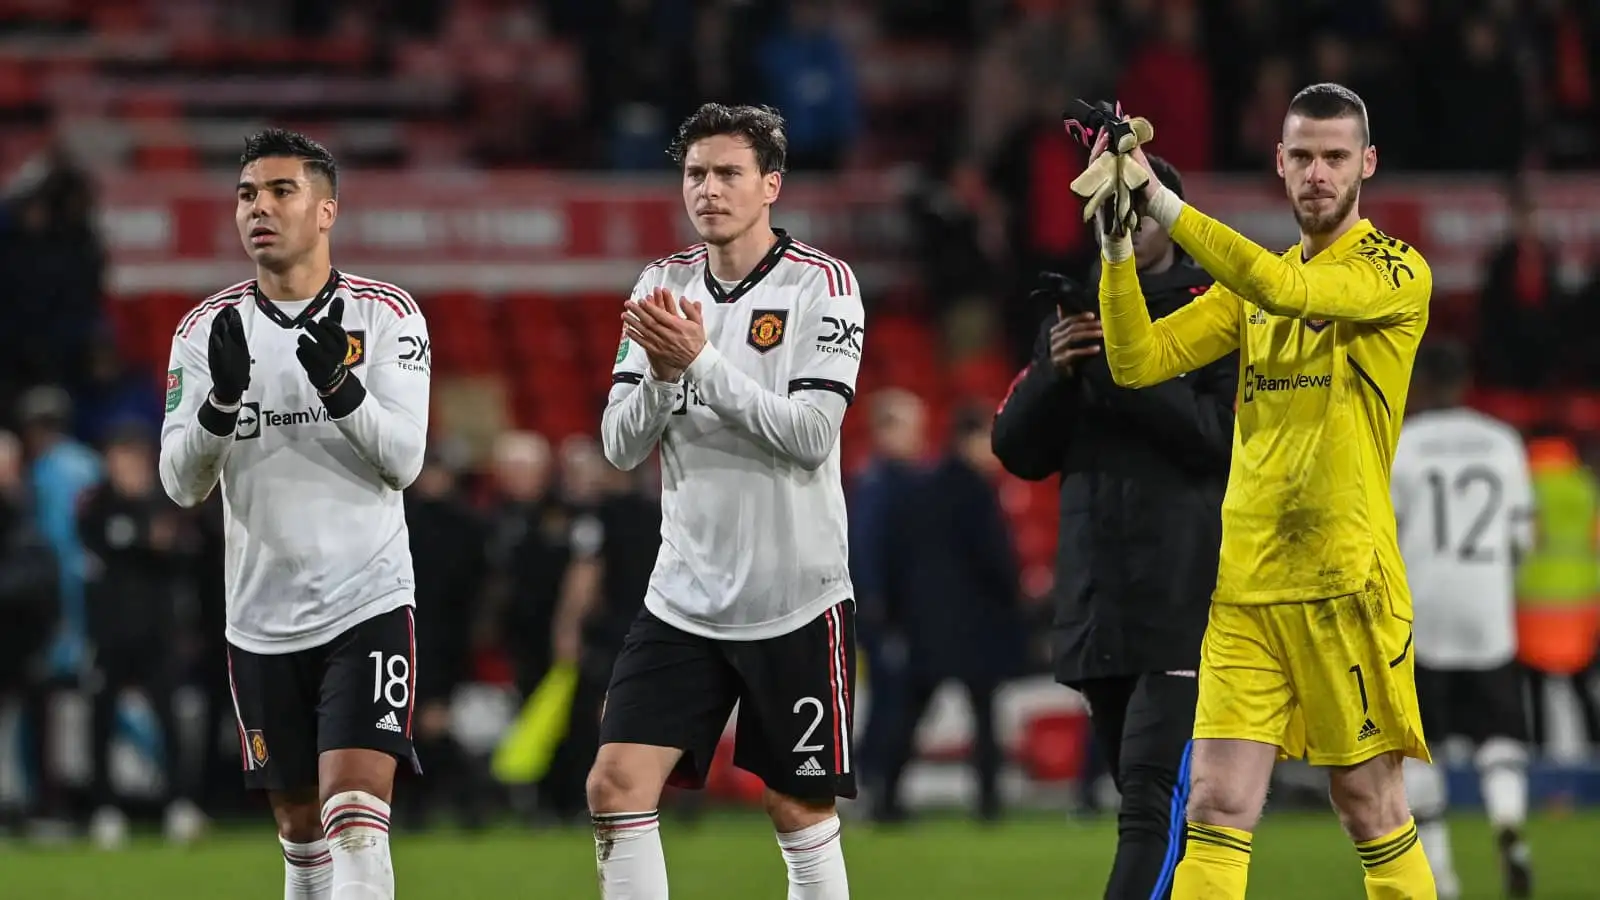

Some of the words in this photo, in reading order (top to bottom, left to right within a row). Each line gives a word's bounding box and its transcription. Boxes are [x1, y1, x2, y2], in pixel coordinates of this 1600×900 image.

[1428, 463, 1503, 565] 12
[368, 651, 409, 708] 18
[1349, 663, 1368, 715] 1
[375, 721, 402, 733] adidas
[792, 696, 825, 753] 2
[1357, 727, 1381, 742] adidas
[795, 767, 826, 776] adidas
